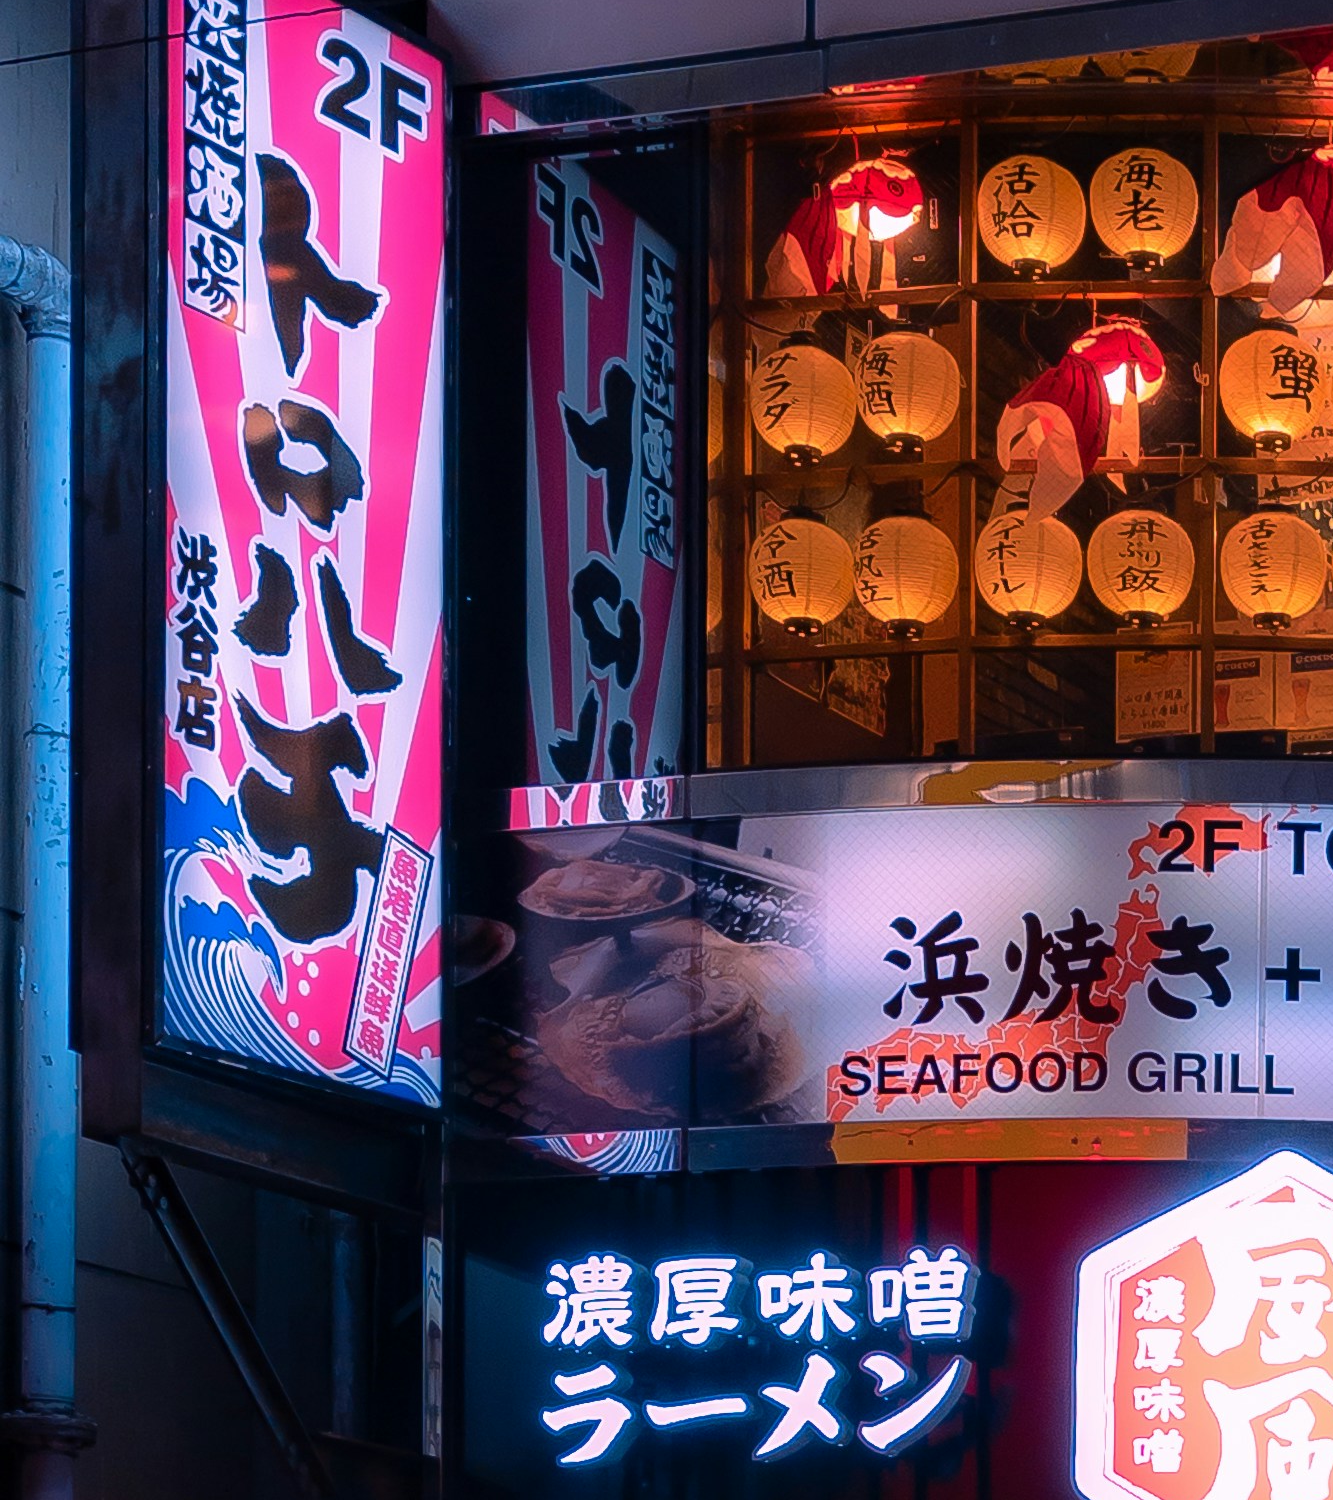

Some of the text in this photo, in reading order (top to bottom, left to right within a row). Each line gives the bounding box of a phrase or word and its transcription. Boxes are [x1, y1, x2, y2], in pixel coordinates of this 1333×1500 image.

[318, 34, 429, 158] 2F
[992, 161, 1043, 239] 活蛤
[1113, 154, 1165, 231] 海老
[759, 352, 800, 431] サラダ
[860, 344, 899, 418] 梅酒
[1265, 343, 1321, 414] 蟹
[234, 150, 404, 944] トロハチ
[754, 524, 798, 600] 冷酒
[175, 530, 219, 753] 渋谷店
[1157, 818, 1242, 874] 2F
[882, 907, 1234, 1027] 浜焼き
[839, 1049, 1109, 1099] SEAFOOD
[1126, 1048, 1296, 1097] GRILL
[541, 1246, 972, 1348] 濃厚味噌
[540, 1350, 968, 1467] ラーメン
